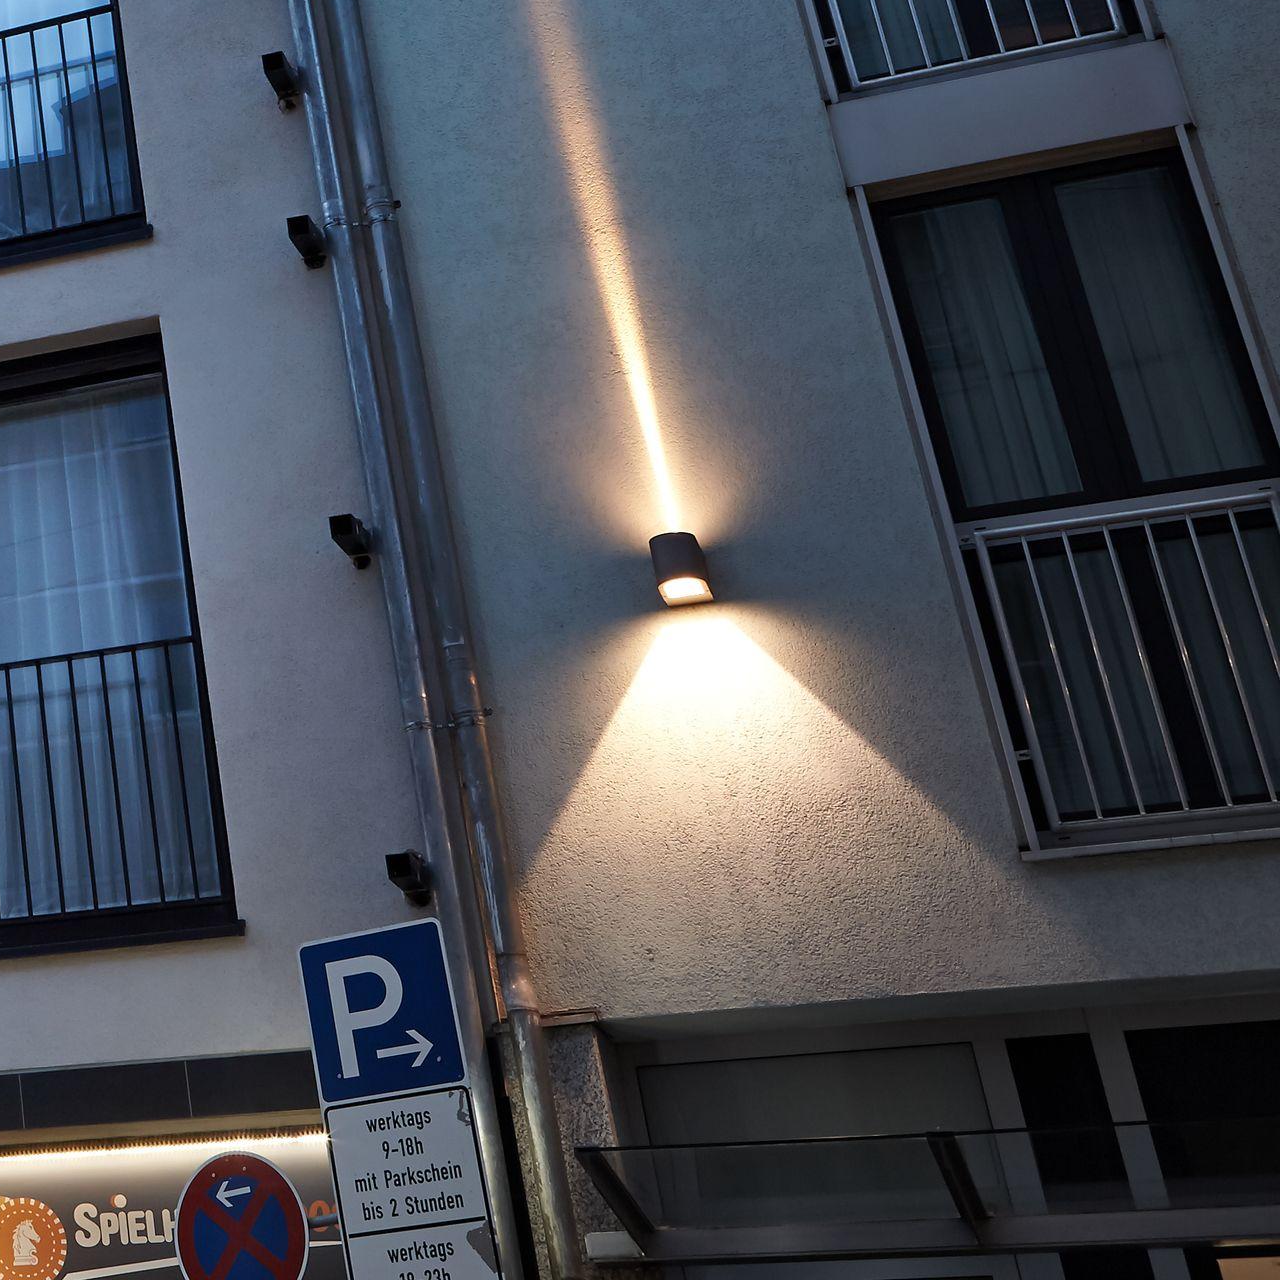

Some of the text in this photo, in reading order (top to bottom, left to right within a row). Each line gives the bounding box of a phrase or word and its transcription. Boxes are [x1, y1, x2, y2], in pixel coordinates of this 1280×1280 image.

[324, 954, 404, 1079] P
[365, 1109, 432, 1133] werktags
[381, 1136, 424, 1160] 9-18h
[354, 1160, 463, 1193] mit Parkschein
[361, 1201, 384, 1221] bis
[389, 1198, 399, 1217] 2
[405, 1191, 464, 1216] Stunden
[386, 1240, 455, 1263] werktags
